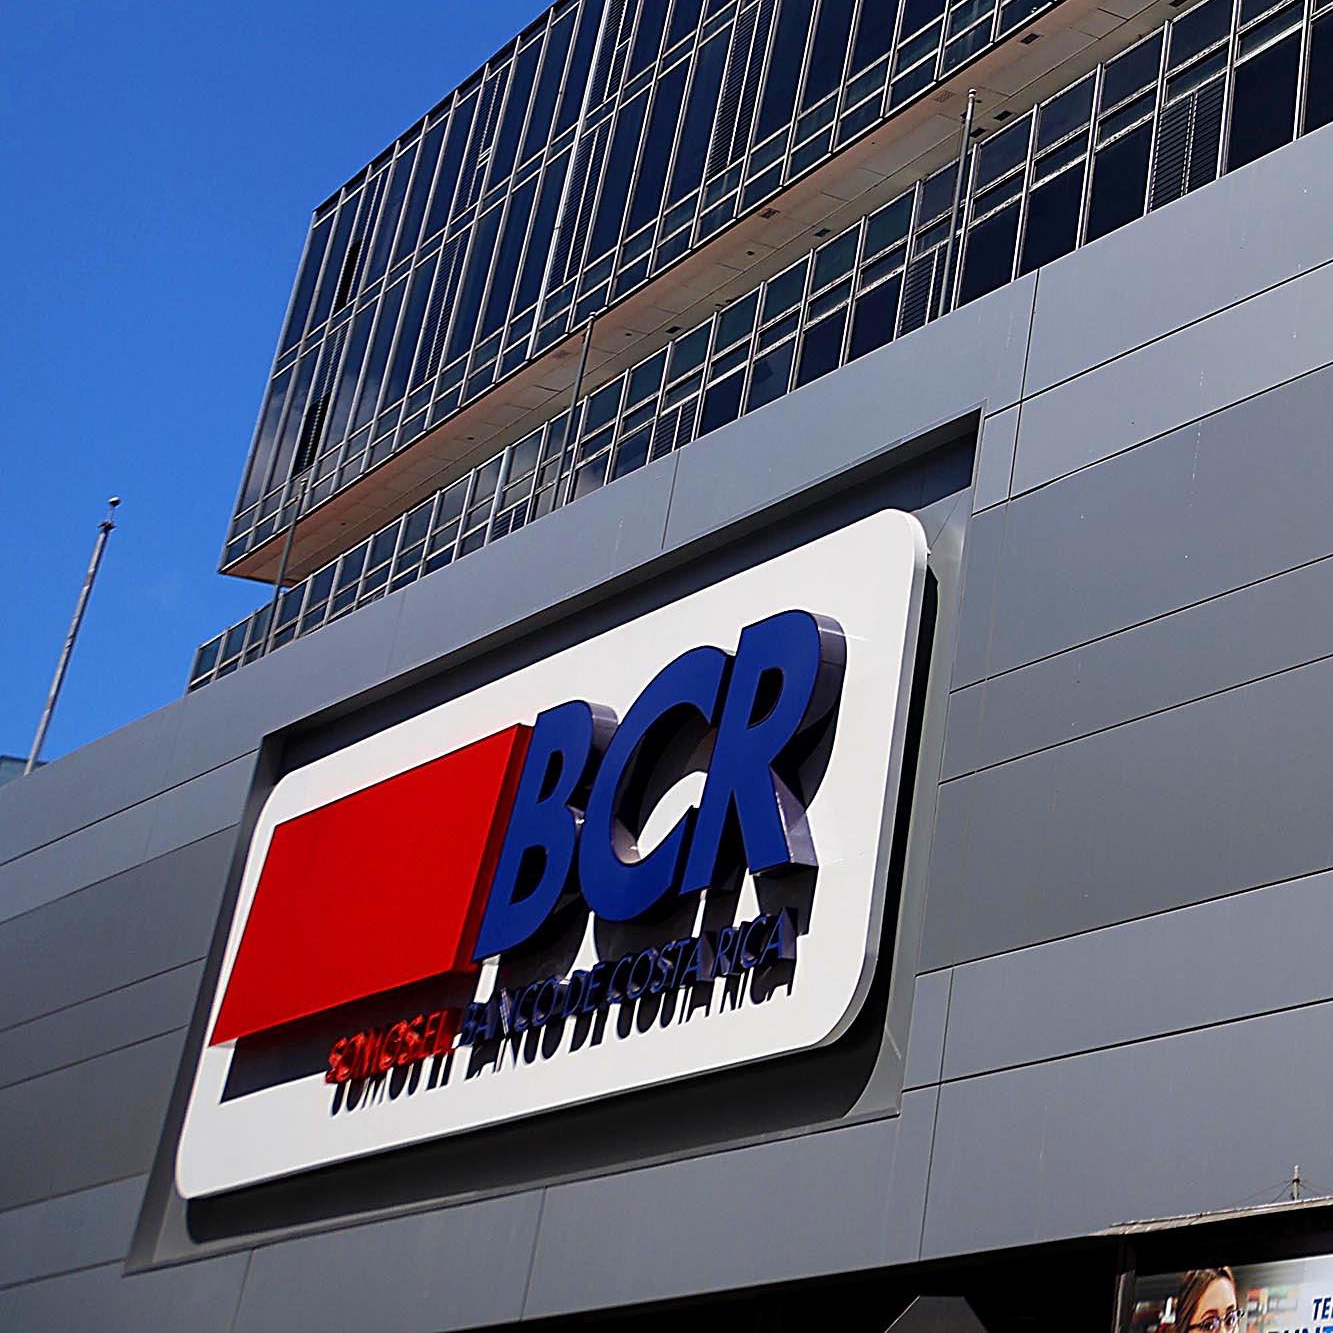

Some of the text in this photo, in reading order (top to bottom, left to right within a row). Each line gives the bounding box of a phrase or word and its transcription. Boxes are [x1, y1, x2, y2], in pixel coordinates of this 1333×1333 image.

[473, 609, 828, 961] BCR
[459, 975, 561, 1047] BANCO
[561, 963, 605, 1018] DE
[606, 932, 713, 1003] COSTA
[711, 906, 797, 978] RICA
